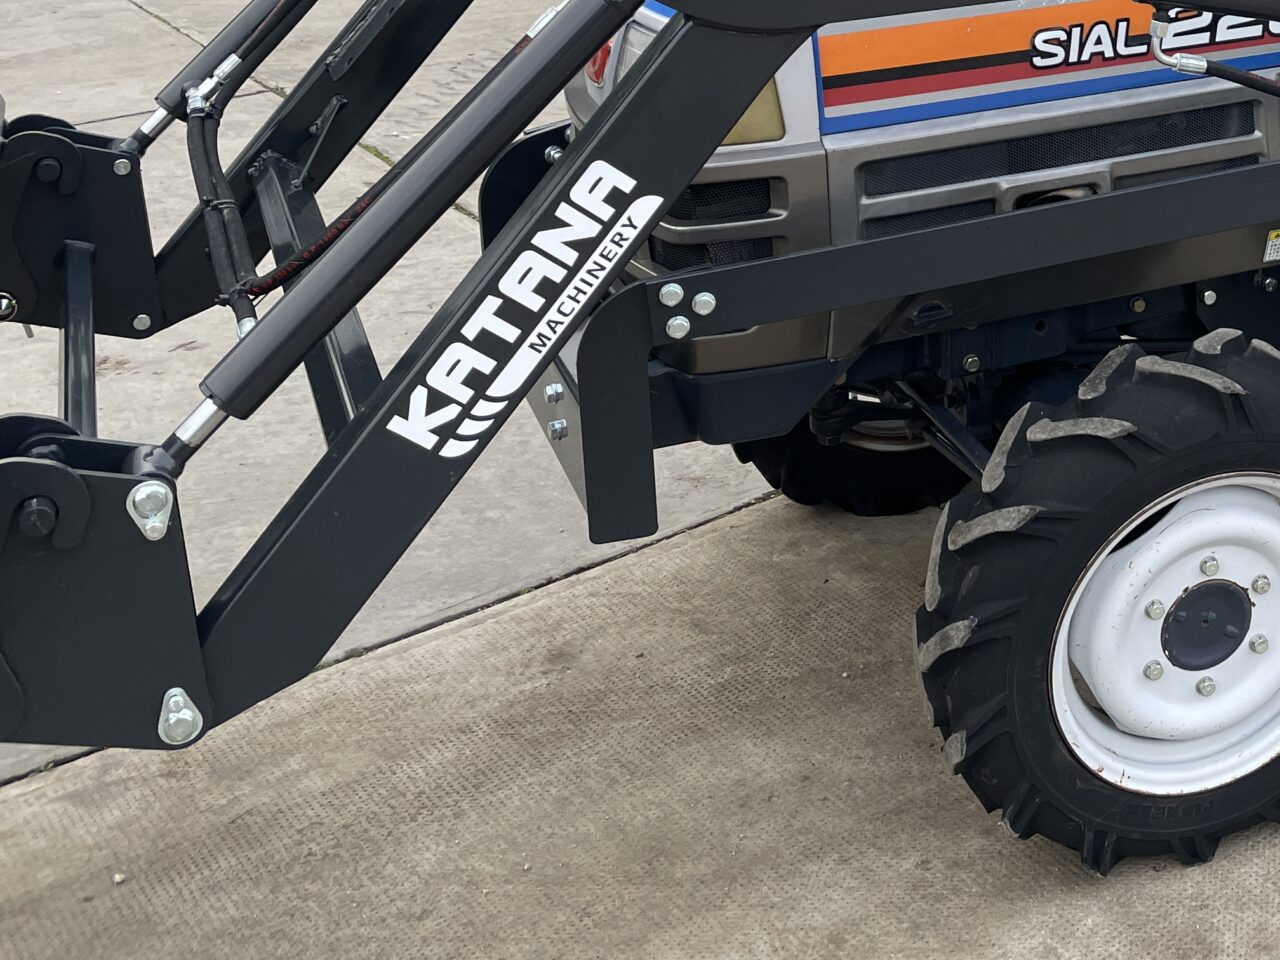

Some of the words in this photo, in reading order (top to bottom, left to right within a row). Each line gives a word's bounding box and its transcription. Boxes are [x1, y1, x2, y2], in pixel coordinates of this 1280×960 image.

[1031, 19, 1149, 69] SIAL
[385, 159, 638, 451] KATANA
[527, 214, 641, 355] MACHINERY
